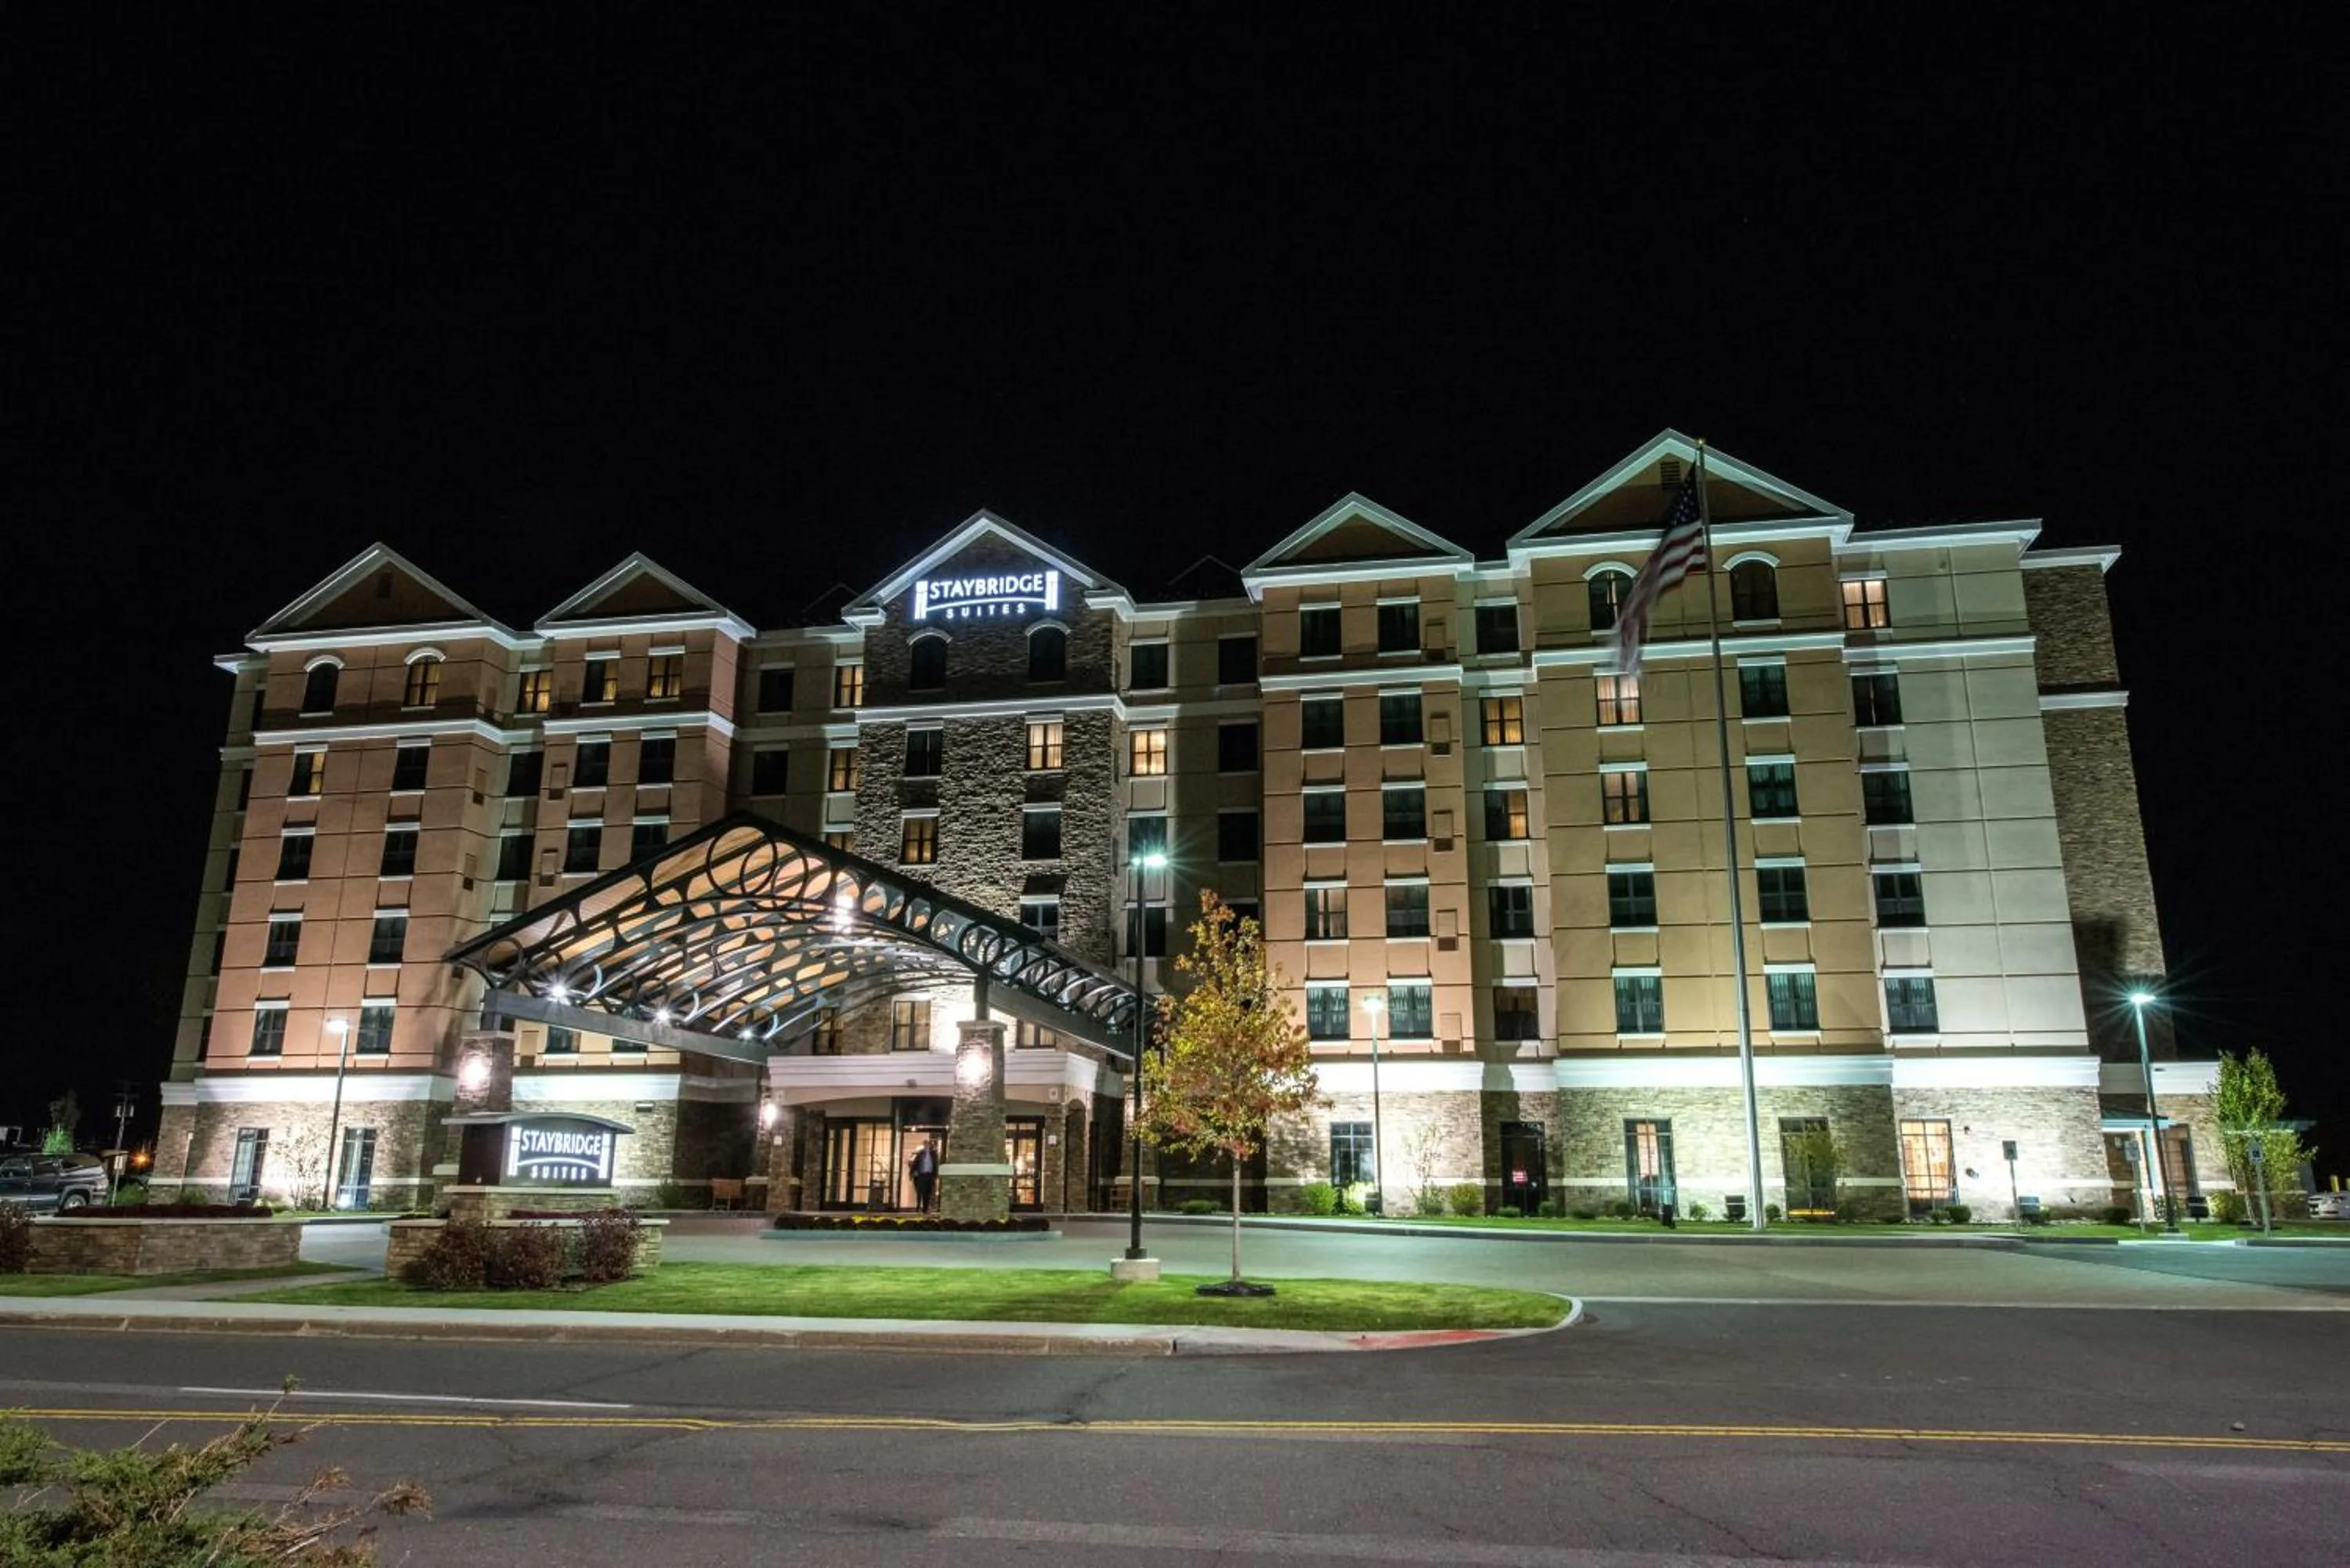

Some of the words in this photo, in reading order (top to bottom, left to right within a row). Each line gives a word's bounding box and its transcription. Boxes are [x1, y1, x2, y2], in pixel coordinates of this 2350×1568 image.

[929, 573, 1044, 599] STAYBRIDGE
[945, 602, 1026, 619] SUITES
[521, 1130, 602, 1154] STAYBRIDGE
[531, 1165, 588, 1179] SUITES
